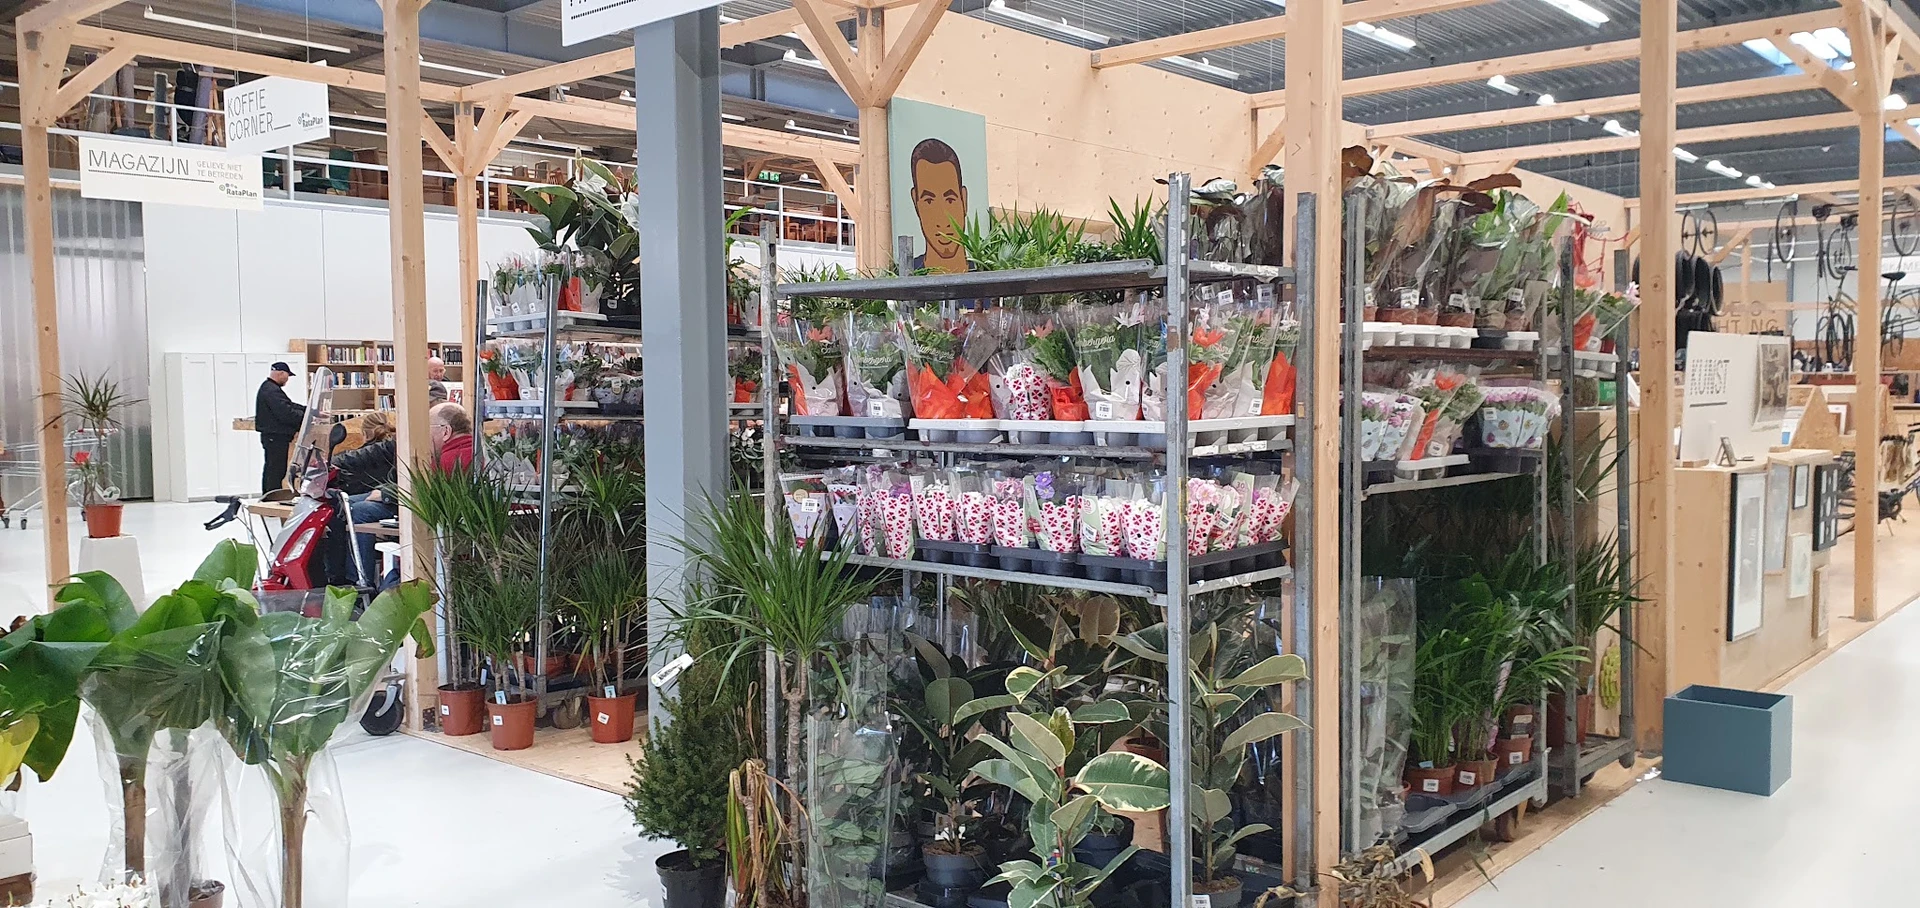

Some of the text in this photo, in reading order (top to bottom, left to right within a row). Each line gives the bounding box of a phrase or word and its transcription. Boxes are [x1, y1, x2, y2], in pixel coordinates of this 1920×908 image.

[227, 88, 266, 119] KOFFIE
[228, 111, 274, 142] CORNER
[302, 116, 324, 128] RataPlan
[88, 149, 190, 176] MAGAZIJN
[196, 160, 242, 172] GELIEVE NIET
[197, 169, 244, 180] TE BETREDEN
[226, 188, 258, 198] RataPlan
[1690, 359, 1730, 395] KUNST
